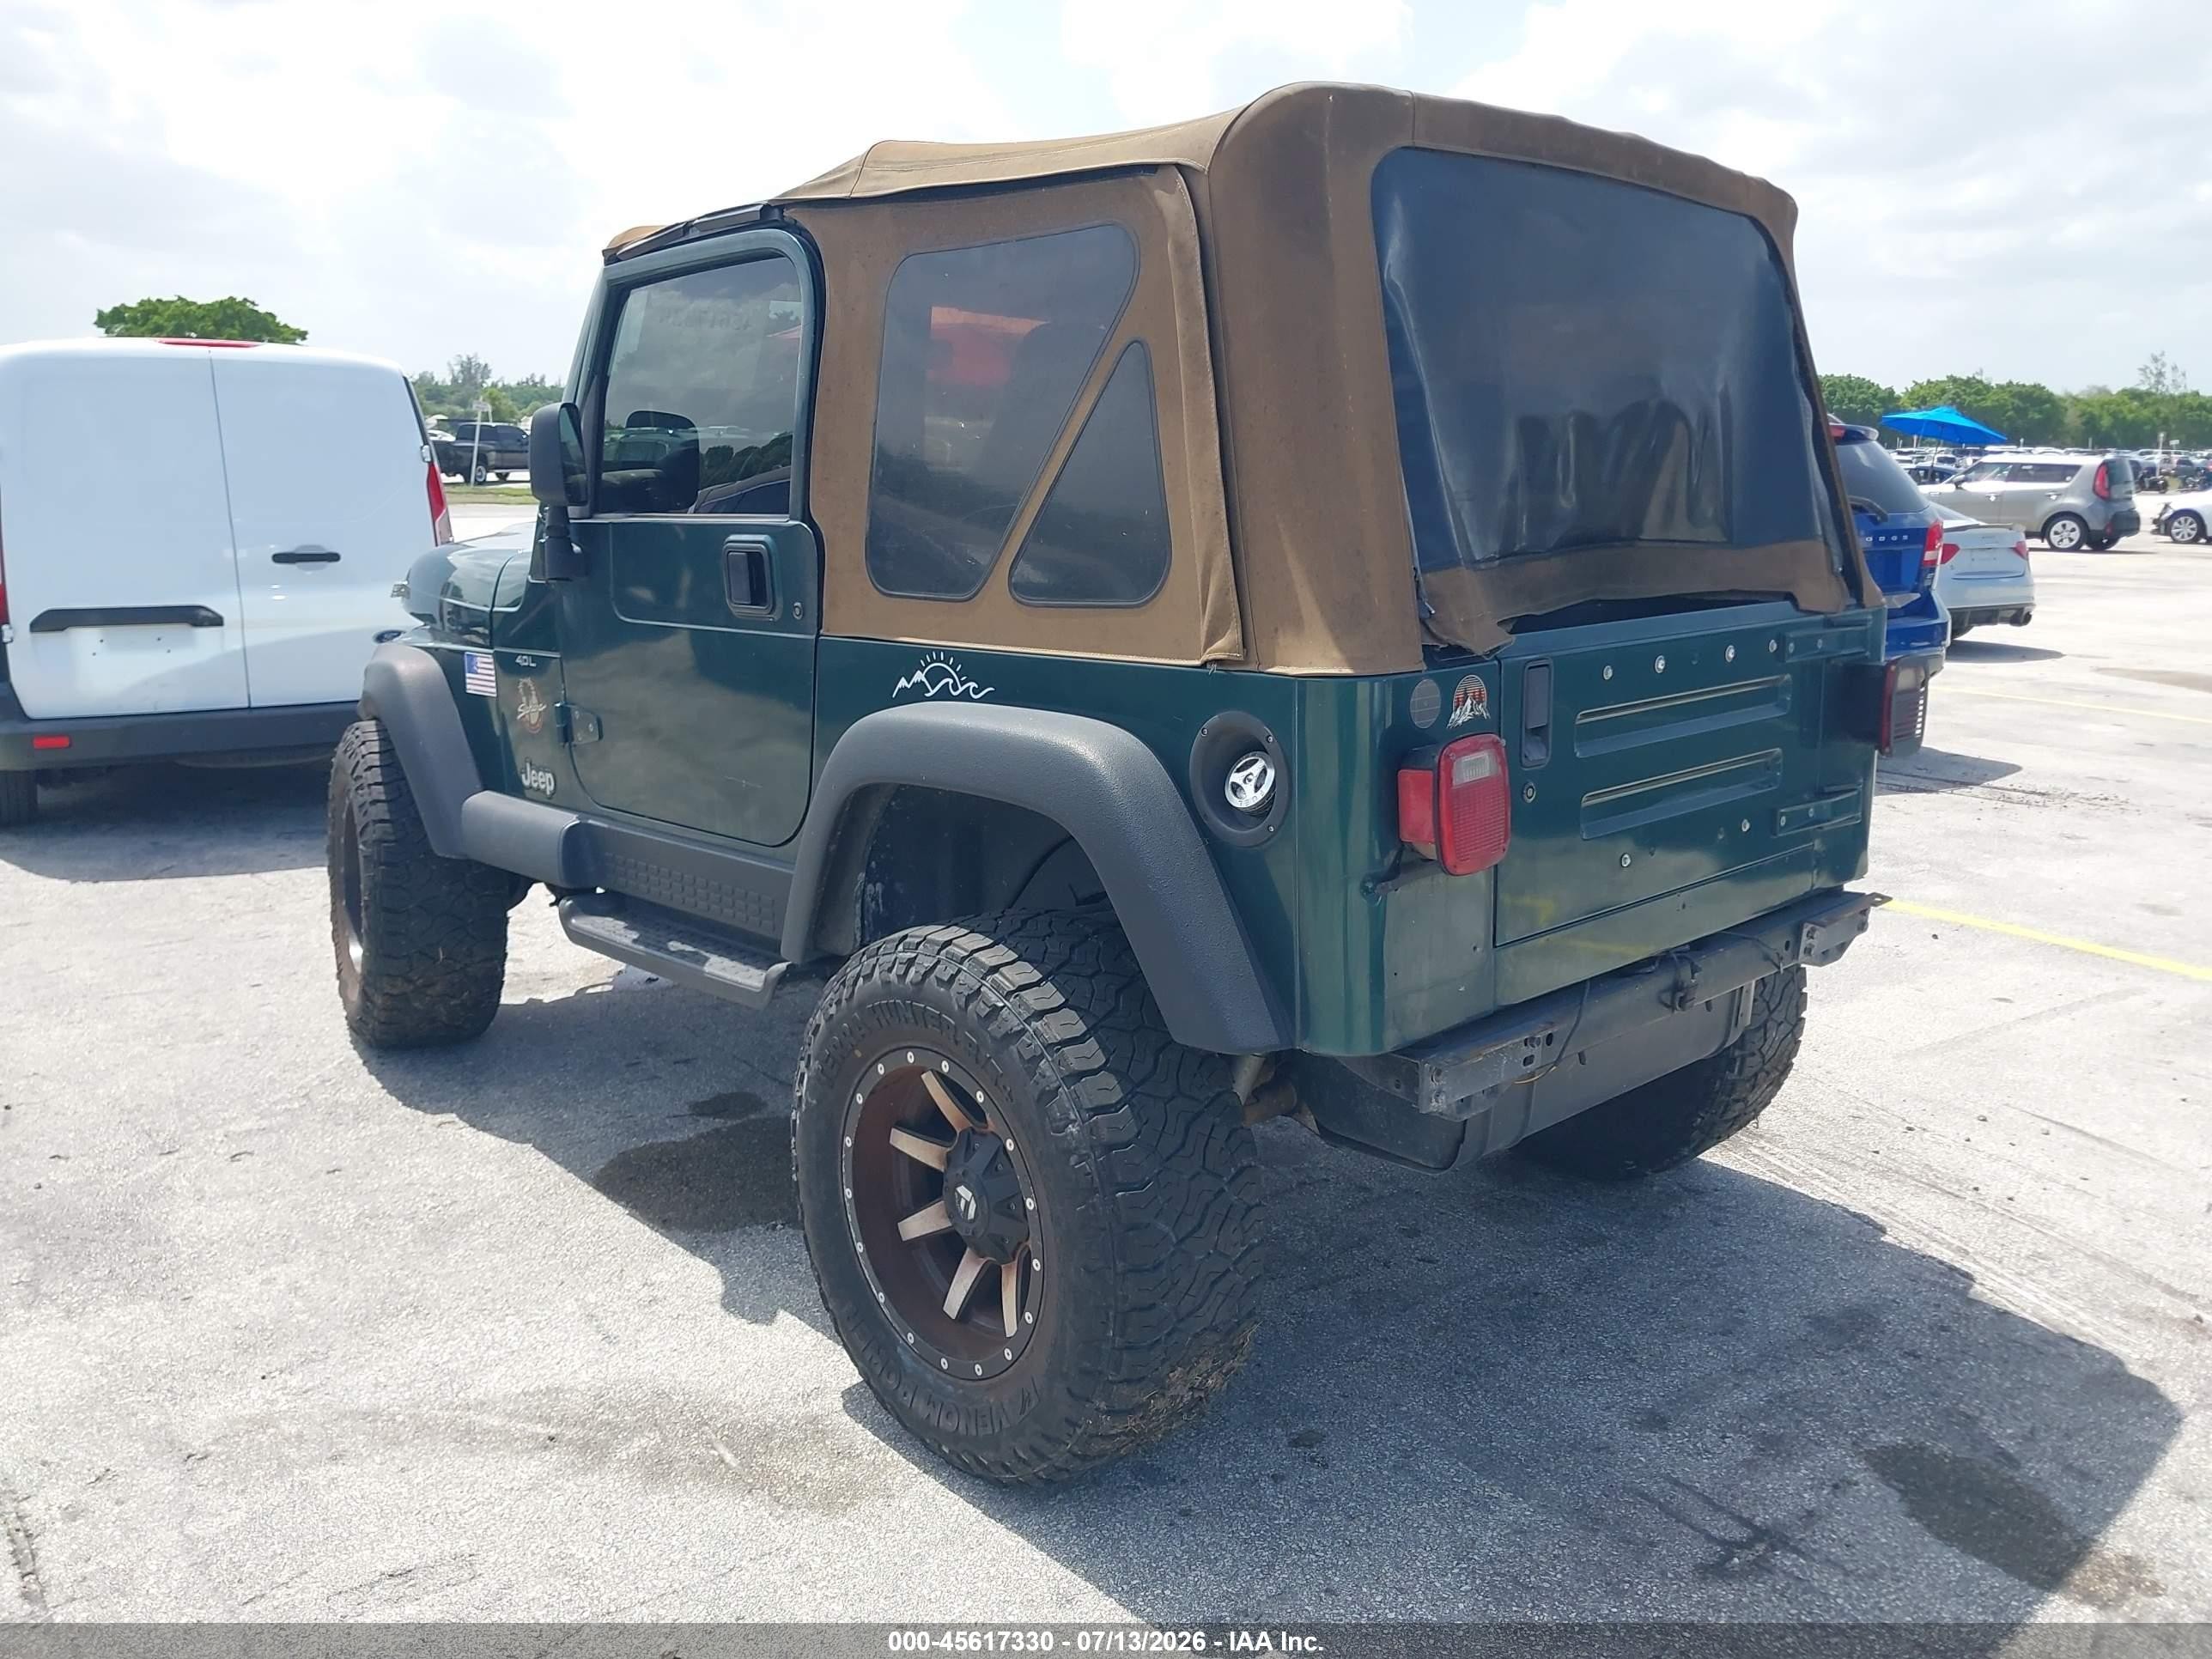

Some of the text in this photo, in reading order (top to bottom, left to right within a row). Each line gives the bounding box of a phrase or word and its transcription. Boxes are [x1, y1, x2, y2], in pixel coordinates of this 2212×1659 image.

[521, 761, 556, 796] Jeep
[817, 1008, 866, 1091] TERRA
[867, 998, 961, 1044] HUNTER
[923, 1388, 1012, 1437] VENOM
